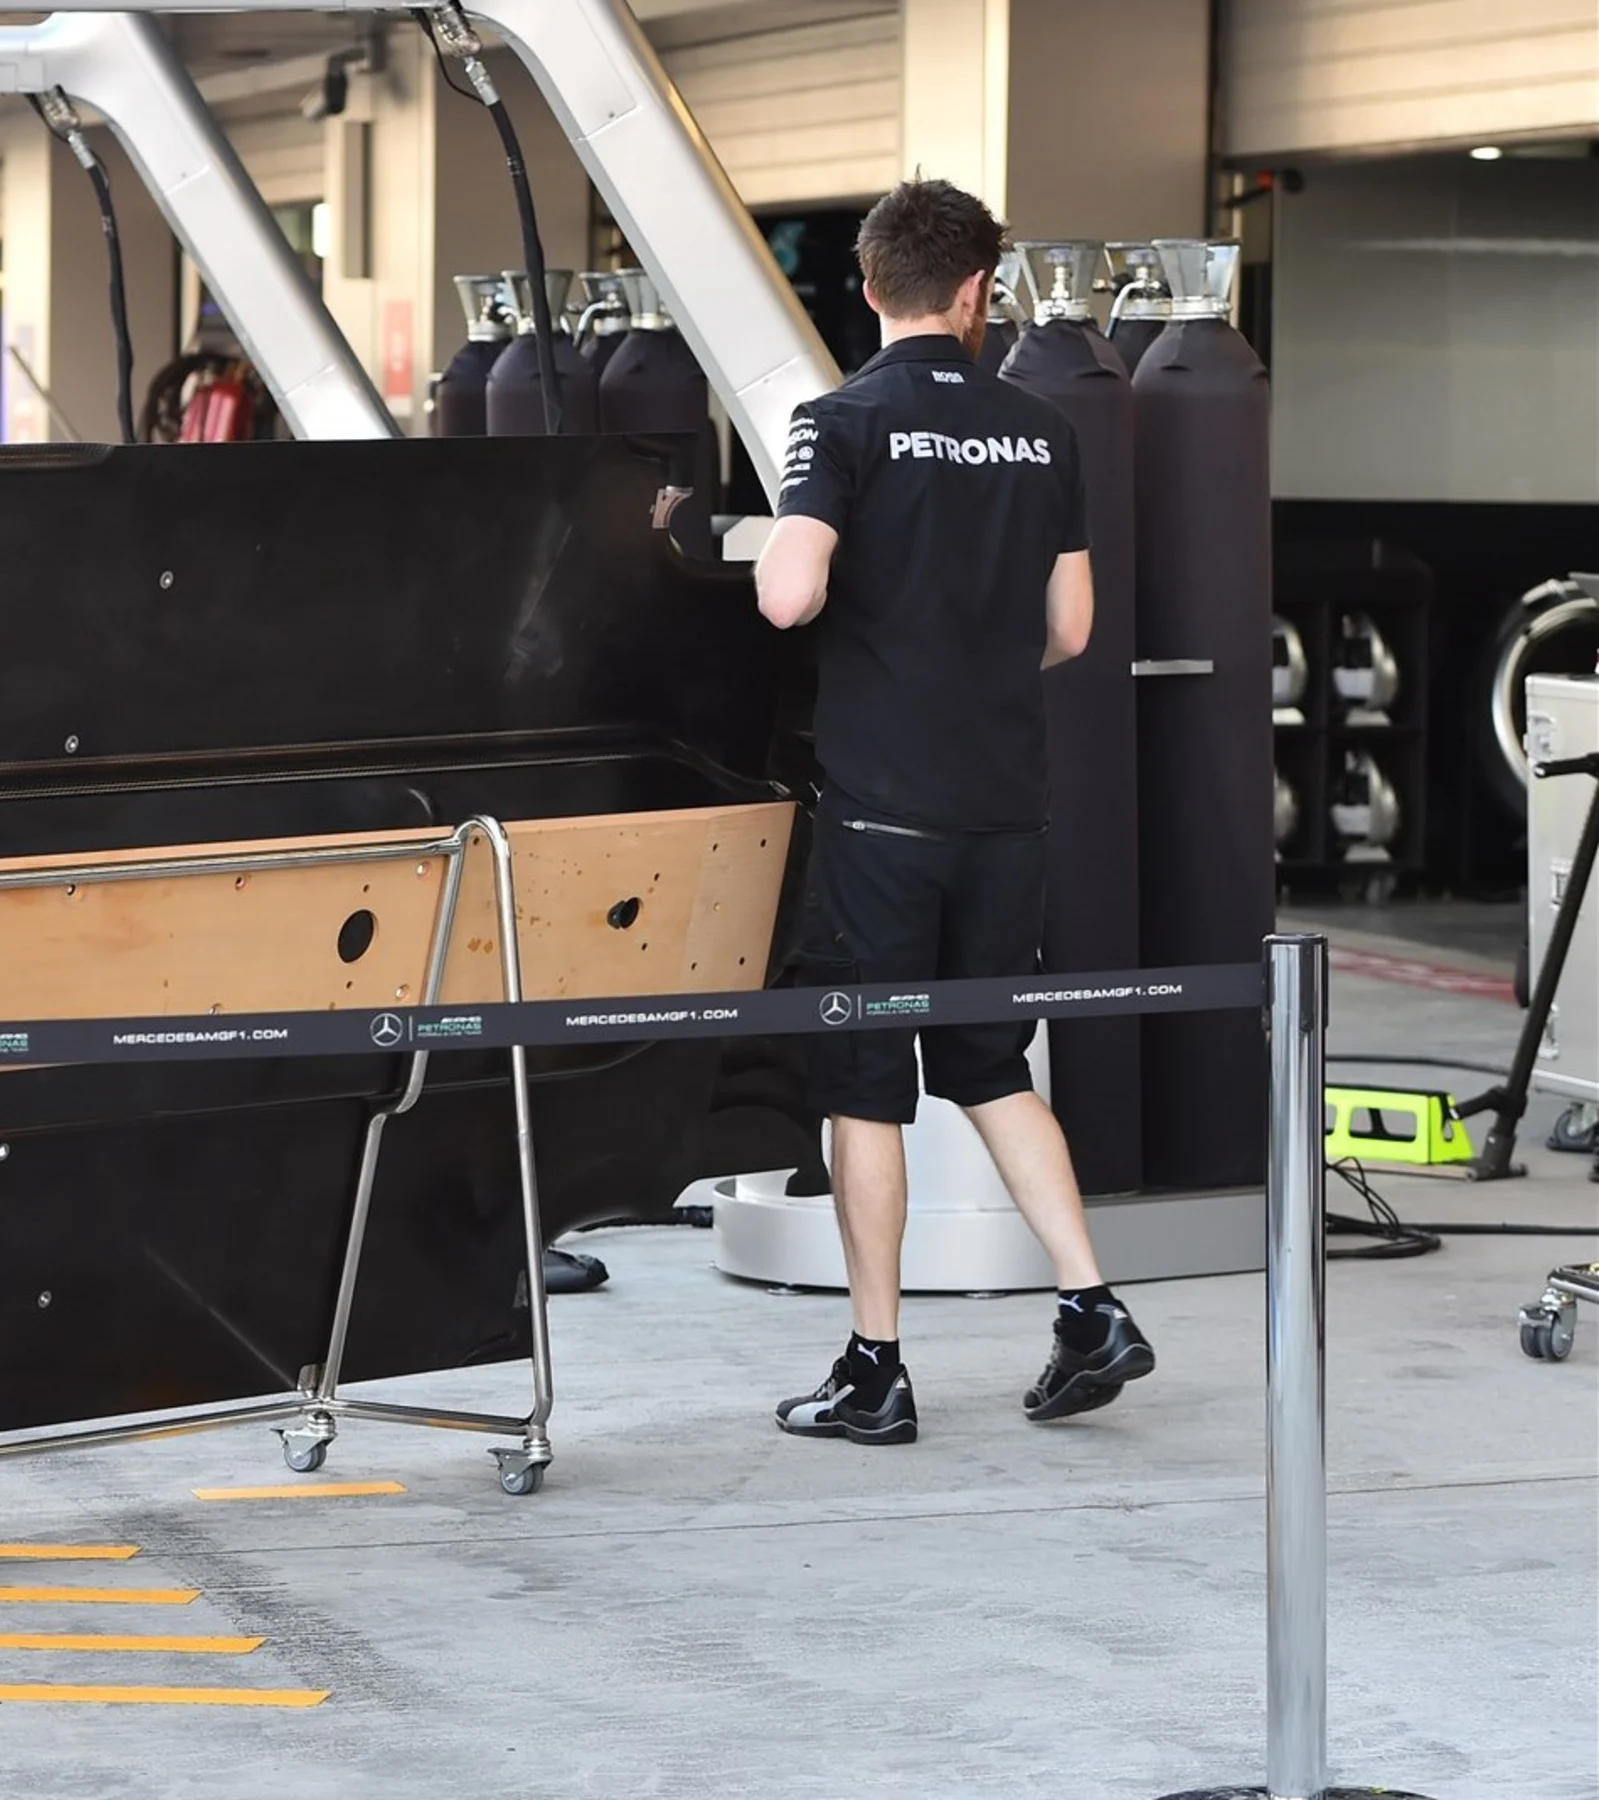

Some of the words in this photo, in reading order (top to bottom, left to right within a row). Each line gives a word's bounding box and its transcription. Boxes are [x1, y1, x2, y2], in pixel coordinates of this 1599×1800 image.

[889, 431, 1051, 465] PETRONAS
[866, 1000, 930, 1010] PETRONAS
[417, 1022, 482, 1033] PETRONAS
